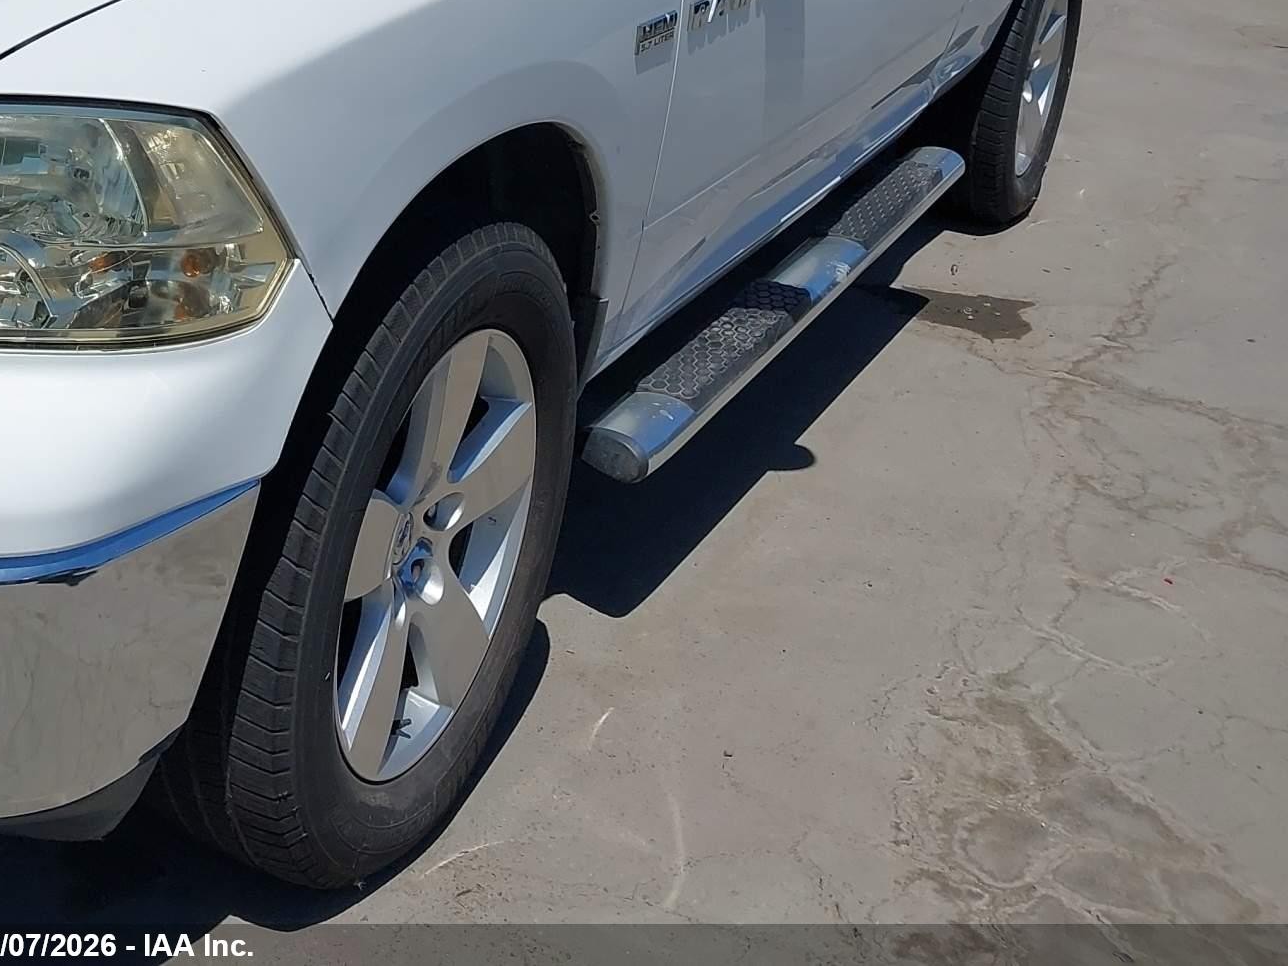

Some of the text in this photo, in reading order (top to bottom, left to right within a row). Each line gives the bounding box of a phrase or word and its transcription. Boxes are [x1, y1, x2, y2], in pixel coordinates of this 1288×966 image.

[641, 11, 679, 38] HEMI
[640, 31, 675, 53] 5.7 LITER
